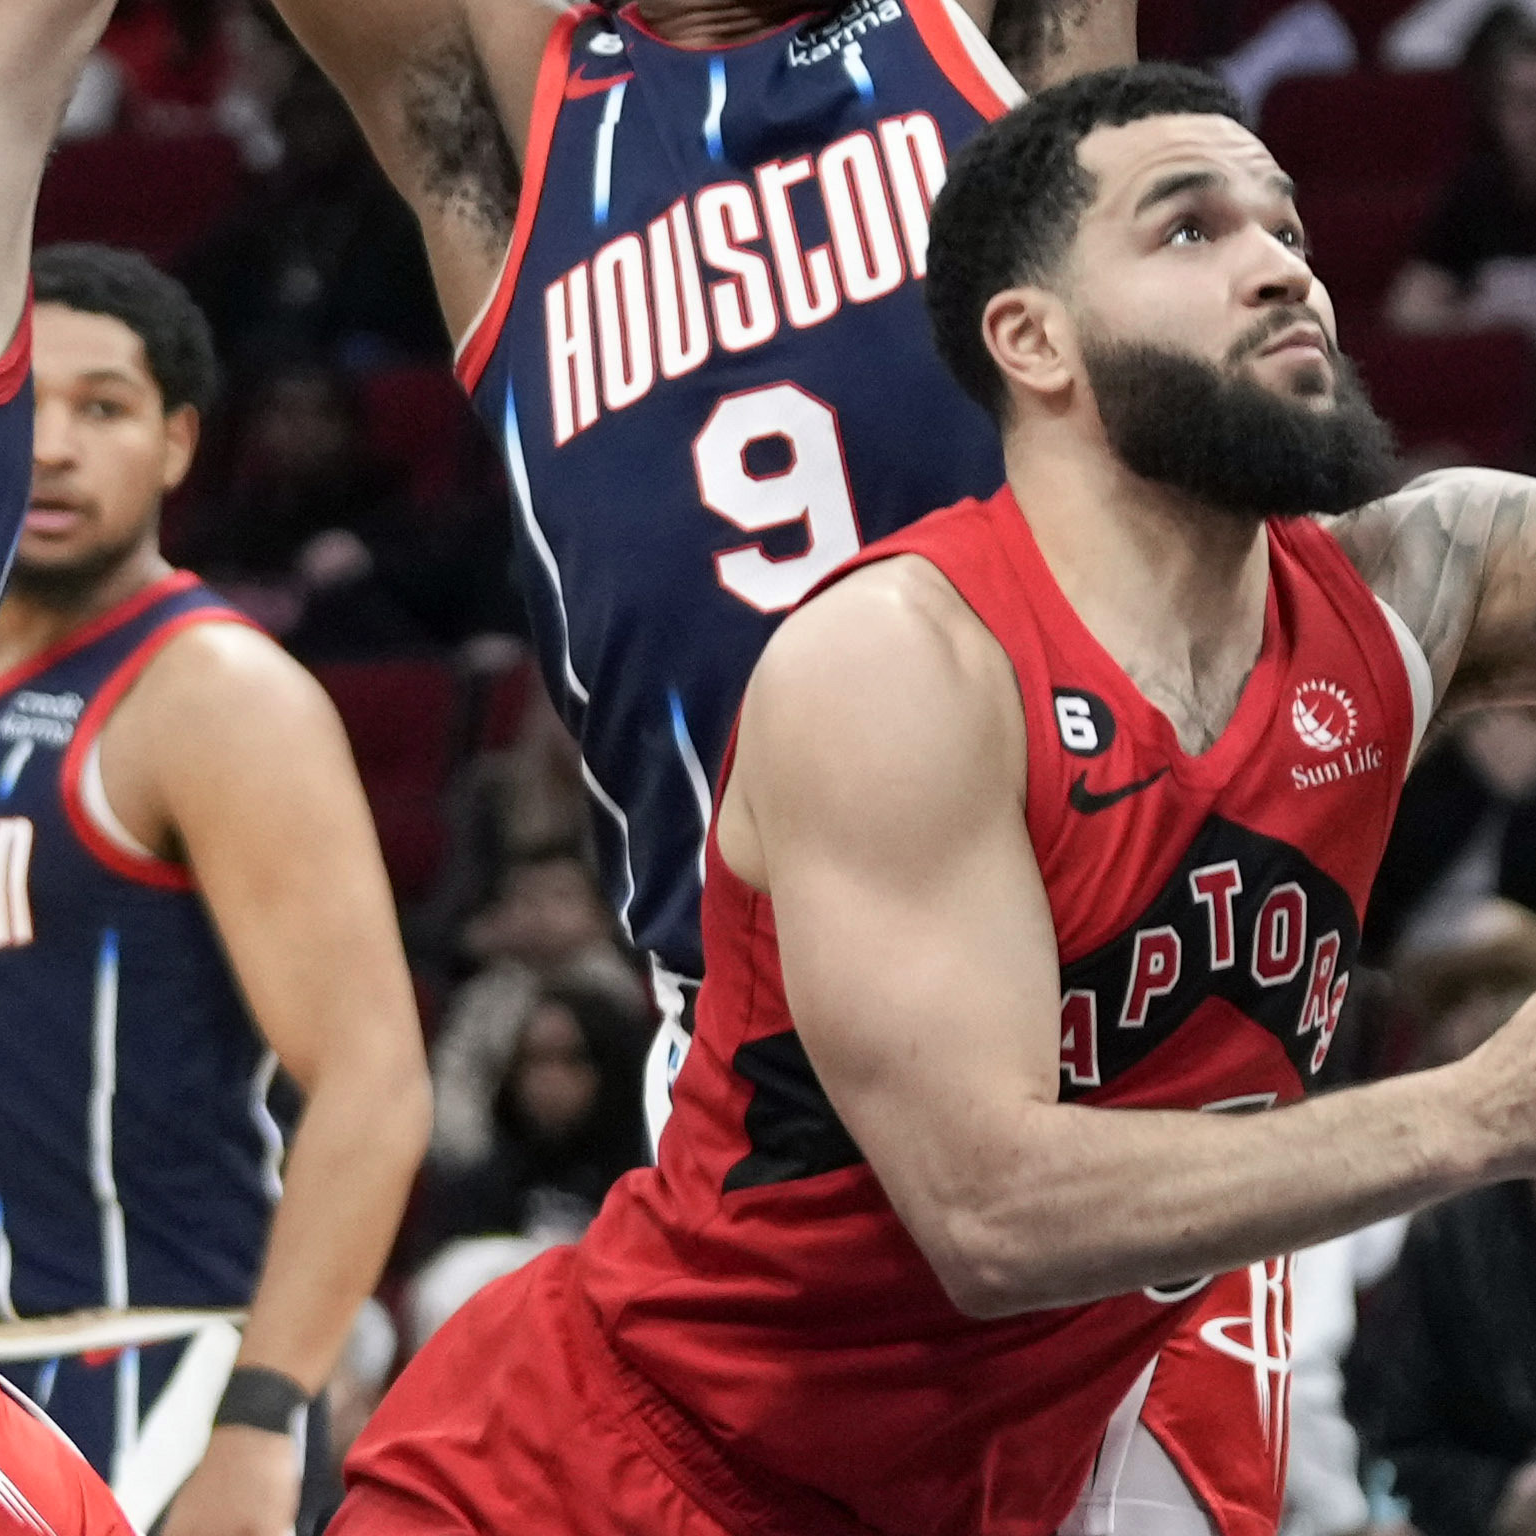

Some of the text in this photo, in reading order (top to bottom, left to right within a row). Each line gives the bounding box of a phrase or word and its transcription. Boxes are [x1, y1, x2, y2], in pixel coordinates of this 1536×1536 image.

[544, 109, 949, 449] HOUSTON
[691, 379, 863, 613] 9
[1055, 694, 1100, 751] 6
[1291, 743, 1384, 792] Sun Life
[1060, 858, 1350, 1087] APTORS
